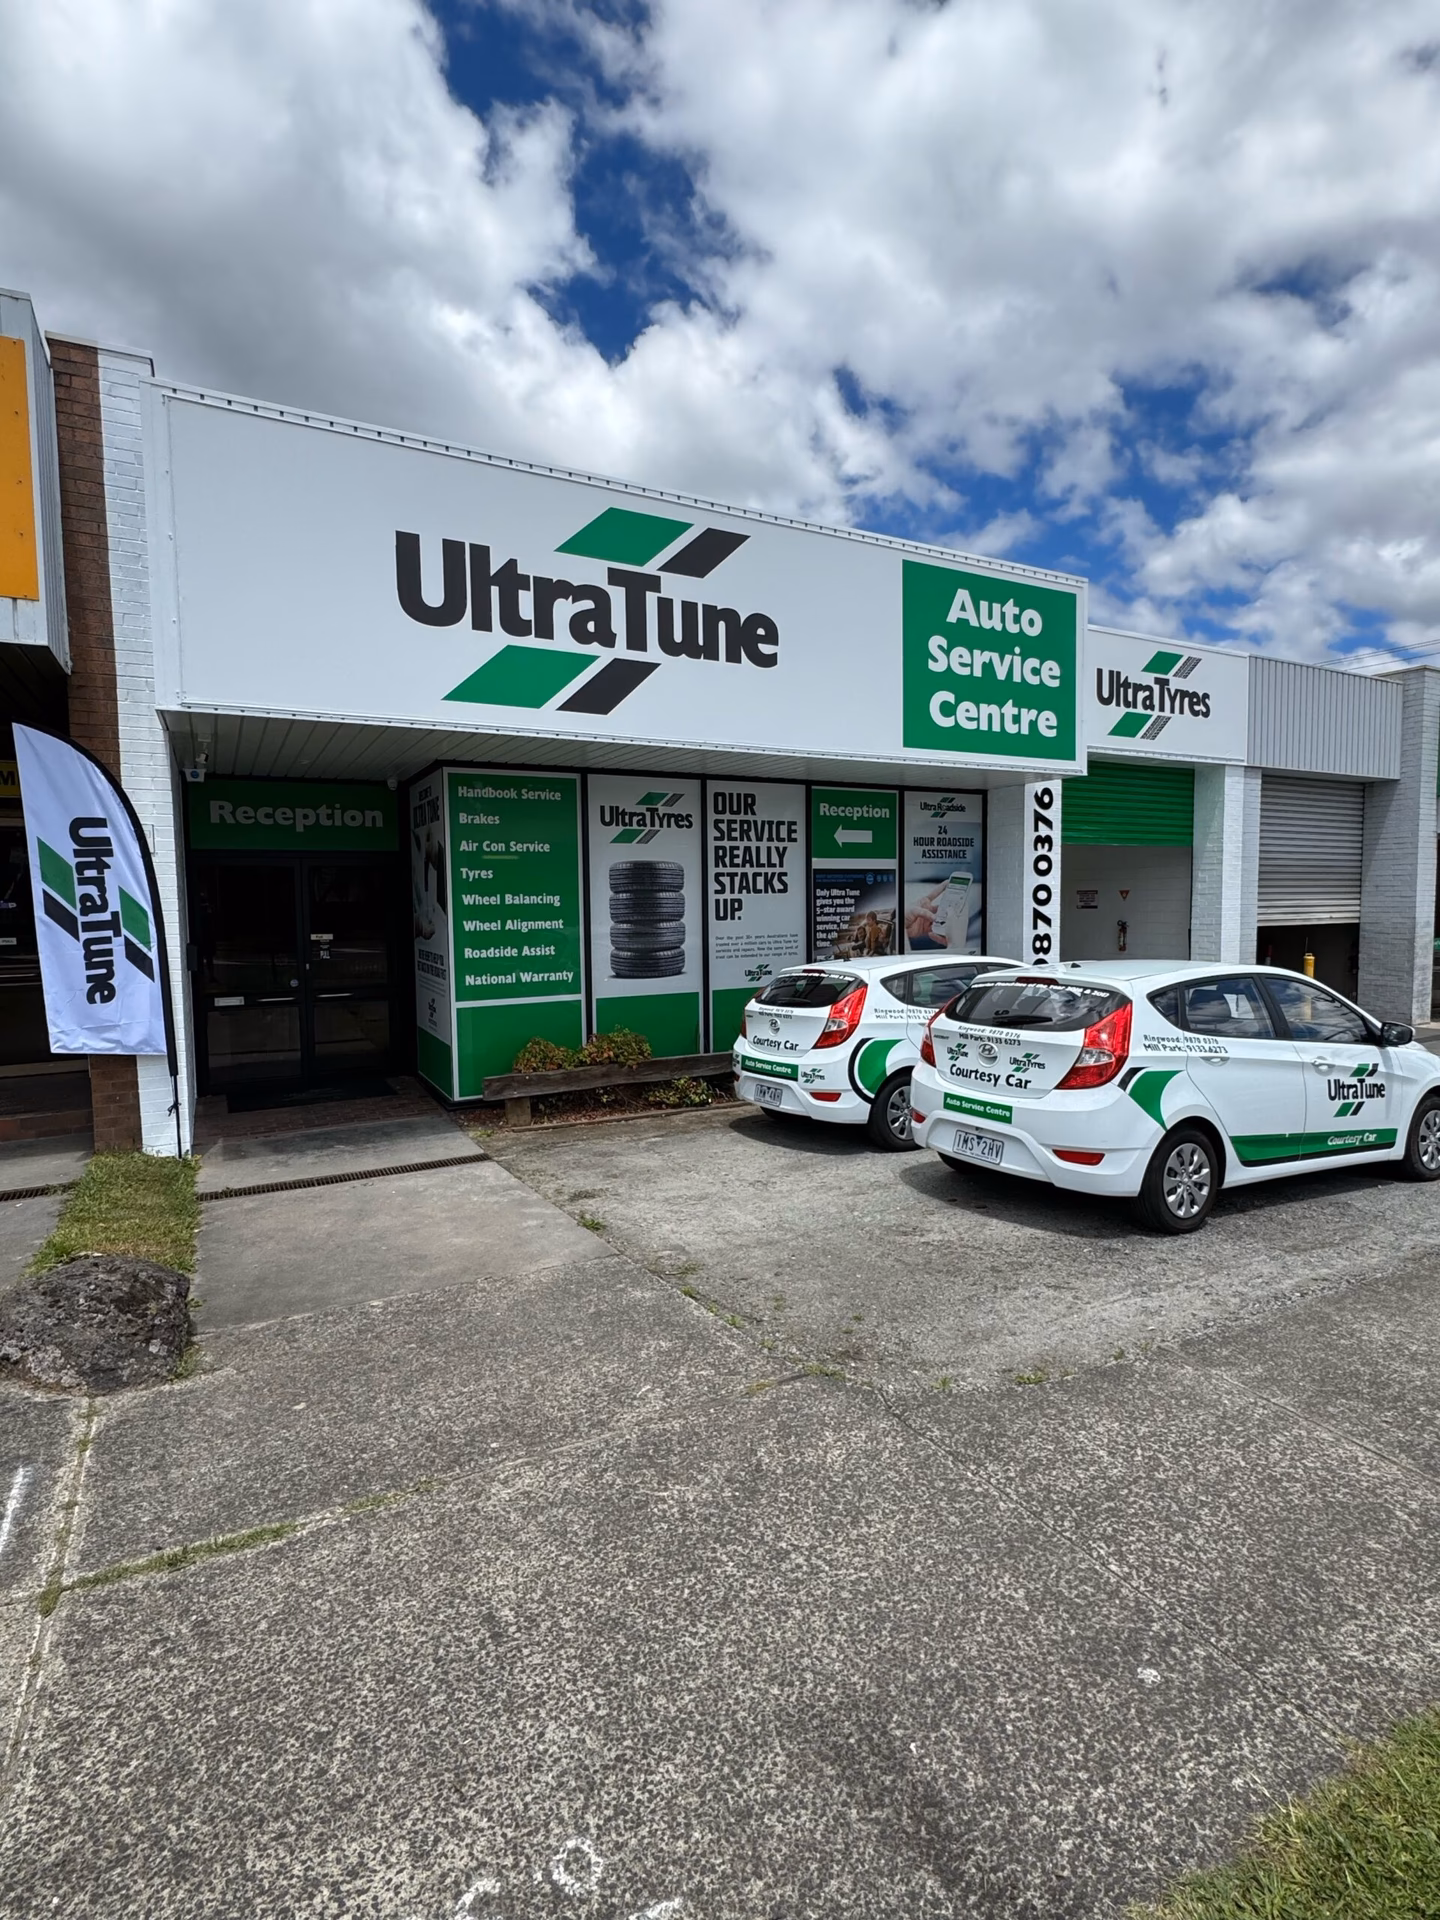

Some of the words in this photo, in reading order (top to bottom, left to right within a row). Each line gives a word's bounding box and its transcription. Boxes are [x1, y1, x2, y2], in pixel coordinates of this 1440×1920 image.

[945, 588, 1043, 637] Auto
[927, 635, 1061, 688] Service
[929, 690, 1058, 738] Centre
[457, 786, 518, 799] Handbook
[521, 788, 562, 801] Service
[713, 791, 757, 816] OUR
[819, 802, 890, 821] Reception
[209, 800, 384, 832] Reception
[459, 812, 500, 825] Brakes
[713, 819, 798, 843] SERVICE
[938, 825, 948, 835] 24
[1033, 787, 1054, 877] 0376
[459, 840, 479, 852] Air
[482, 840, 506, 852] Con
[510, 841, 551, 853] Service
[913, 836, 935, 847] HOUR
[936, 837, 975, 847] ROADSIDE
[714, 845, 788, 869] REALLY
[921, 849, 967, 859] ASSISTANCE
[460, 867, 494, 881] Tyres
[714, 871, 789, 895] STACKS
[462, 893, 501, 906] Wheel
[505, 893, 561, 907] Balancing
[714, 897, 743, 921] UP.
[836, 905, 855, 913] award
[463, 919, 501, 932] Wheel
[505, 918, 564, 932] Alignment
[464, 947, 518, 959] Roadside
[521, 945, 555, 957] Assist
[465, 972, 517, 986] National
[519, 970, 574, 984] Warranty
[752, 1035, 782, 1050] Courtesy
[784, 1040, 799, 1051] Car
[1143, 1043, 1161, 1052] Mill
[772, 1064, 792, 1074] Centre
[949, 1063, 1001, 1087] Courtesy
[1005, 1074, 1032, 1090] Car
[946, 1097, 961, 1106] Auto
[961, 1100, 985, 1112] Service
[985, 1105, 1011, 1117] Centre
[1327, 1135, 1363, 1146] Courtesy
[1363, 1132, 1378, 1142] Car
